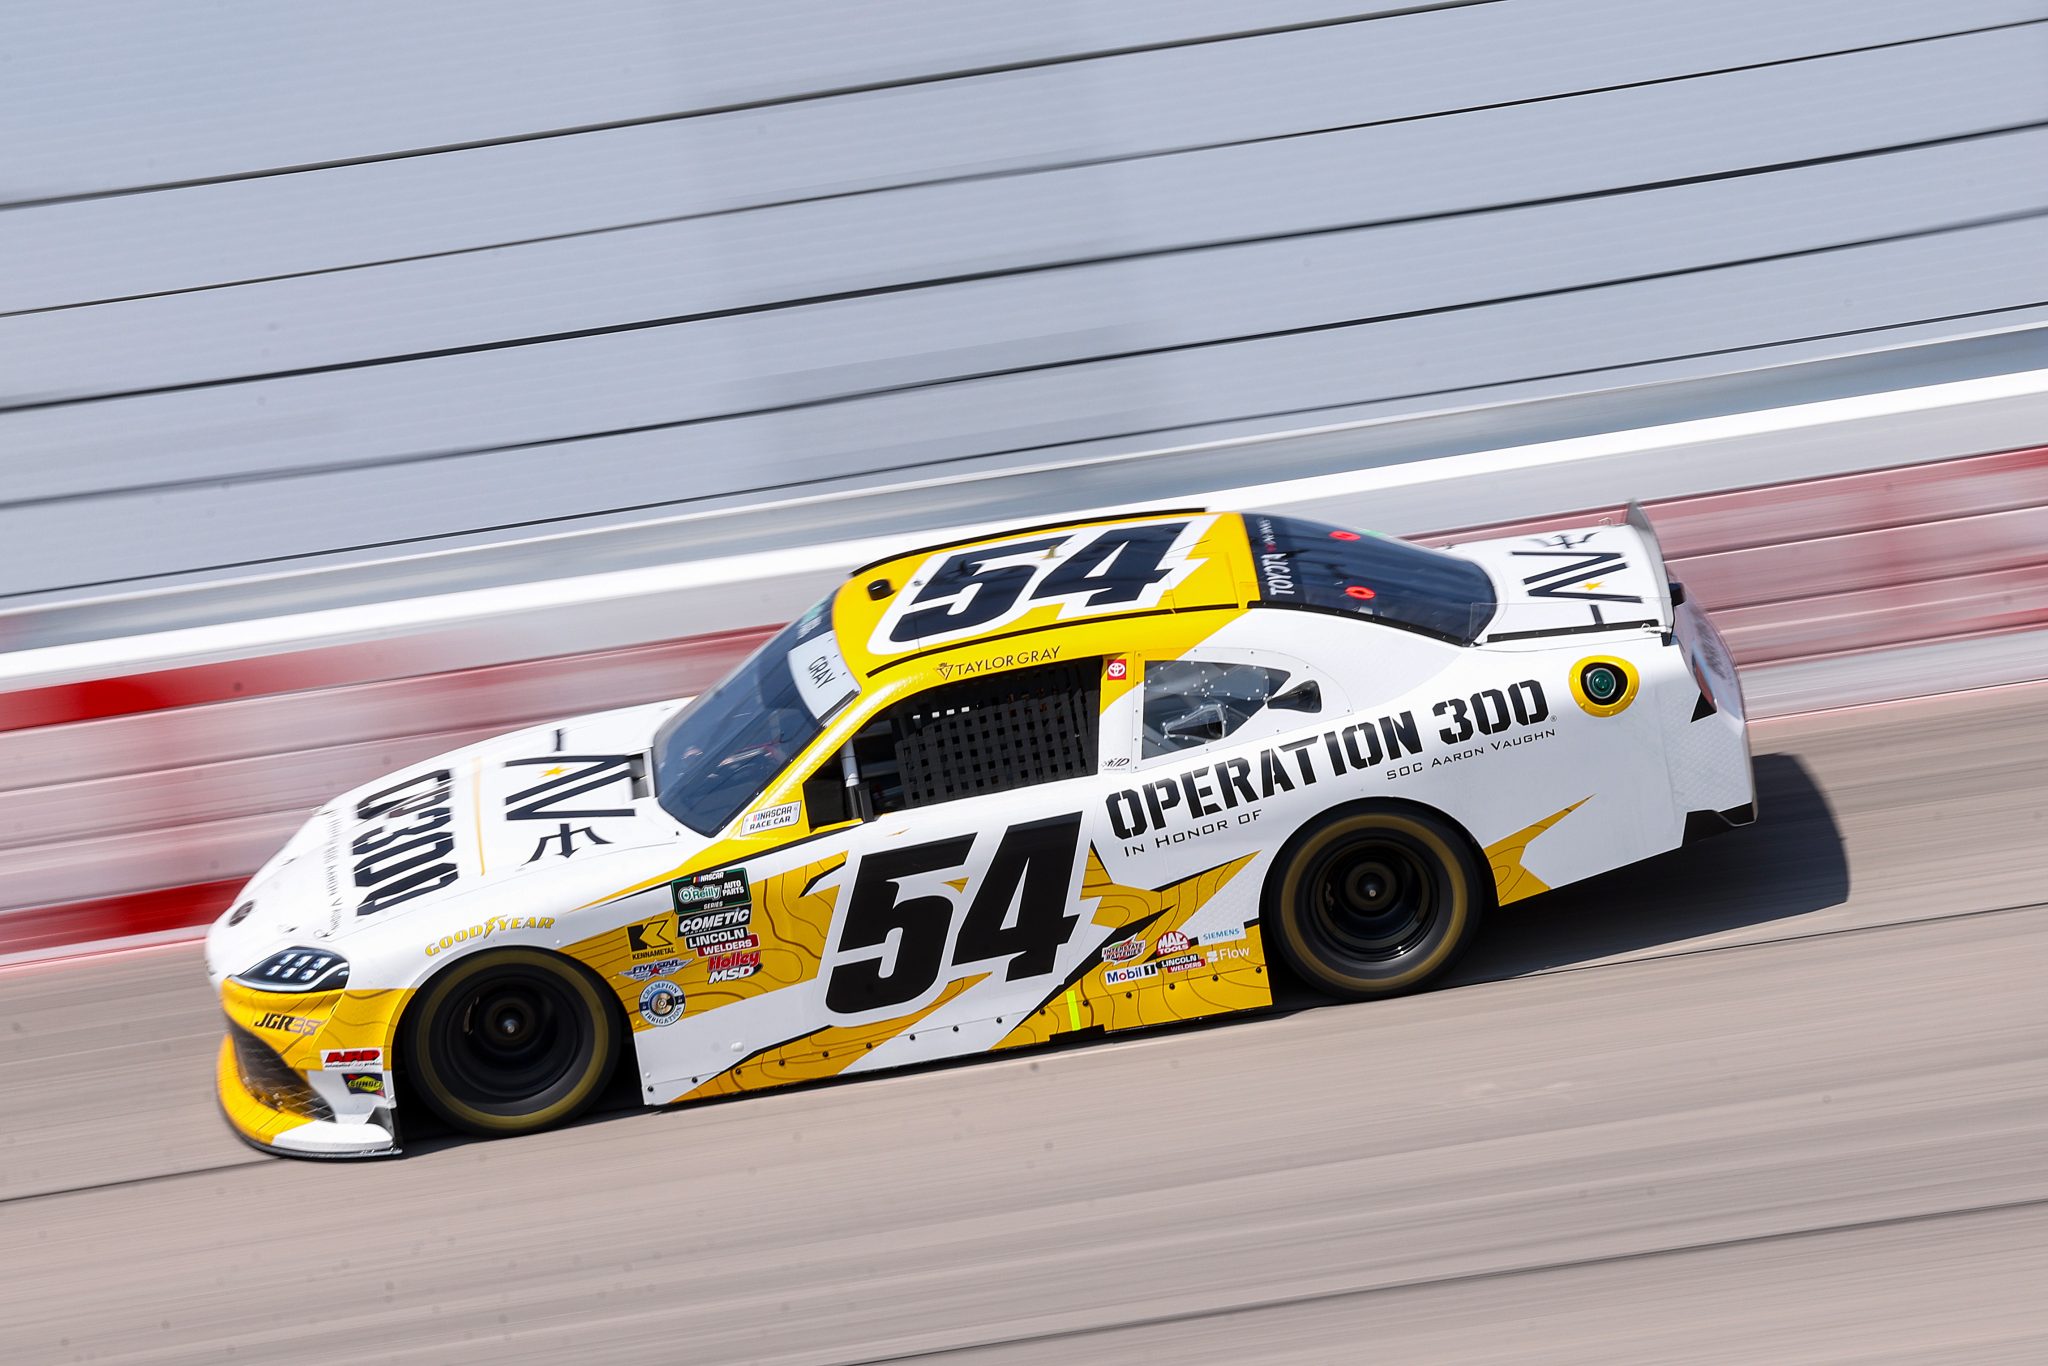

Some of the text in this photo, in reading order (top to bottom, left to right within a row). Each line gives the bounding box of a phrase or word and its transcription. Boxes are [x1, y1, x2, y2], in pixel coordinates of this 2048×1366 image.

[889, 520, 1193, 642] 54
[955, 646, 1060, 675] TAYLOR GRAY
[808, 655, 836, 688] GRAY
[1387, 729, 1555, 780] SOC AARON VAUGHN
[1105, 710, 1423, 841] OPERATION
[758, 806, 793, 820] NASCAR
[750, 815, 791, 831] RACE CAR
[1124, 809, 1262, 857] IN HONOR OF
[700, 872, 725, 882] NASCAR
[723, 880, 742, 890] AUTO
[679, 884, 720, 903] O'Reilly
[722, 886, 744, 897] PARTS
[703, 901, 723, 910] SERIES
[825, 810, 1084, 1014] 54
[679, 908, 750, 933] COMETIC
[425, 914, 556, 957] GOODYEAR
[689, 929, 745, 948] LINCOLN
[1203, 928, 1240, 940] SIEMENS
[632, 947, 676, 960] KENNAMETAL
[703, 939, 752, 955] WELDERS
[1158, 944, 1188, 955] TOOLS
[1219, 947, 1250, 960] Flow
[708, 950, 761, 972] Holley
[1161, 955, 1197, 967] LINCOLN
[1170, 962, 1202, 973] WELDERS
[708, 966, 754, 984] MSD
[1106, 967, 1142, 983] Mobil
